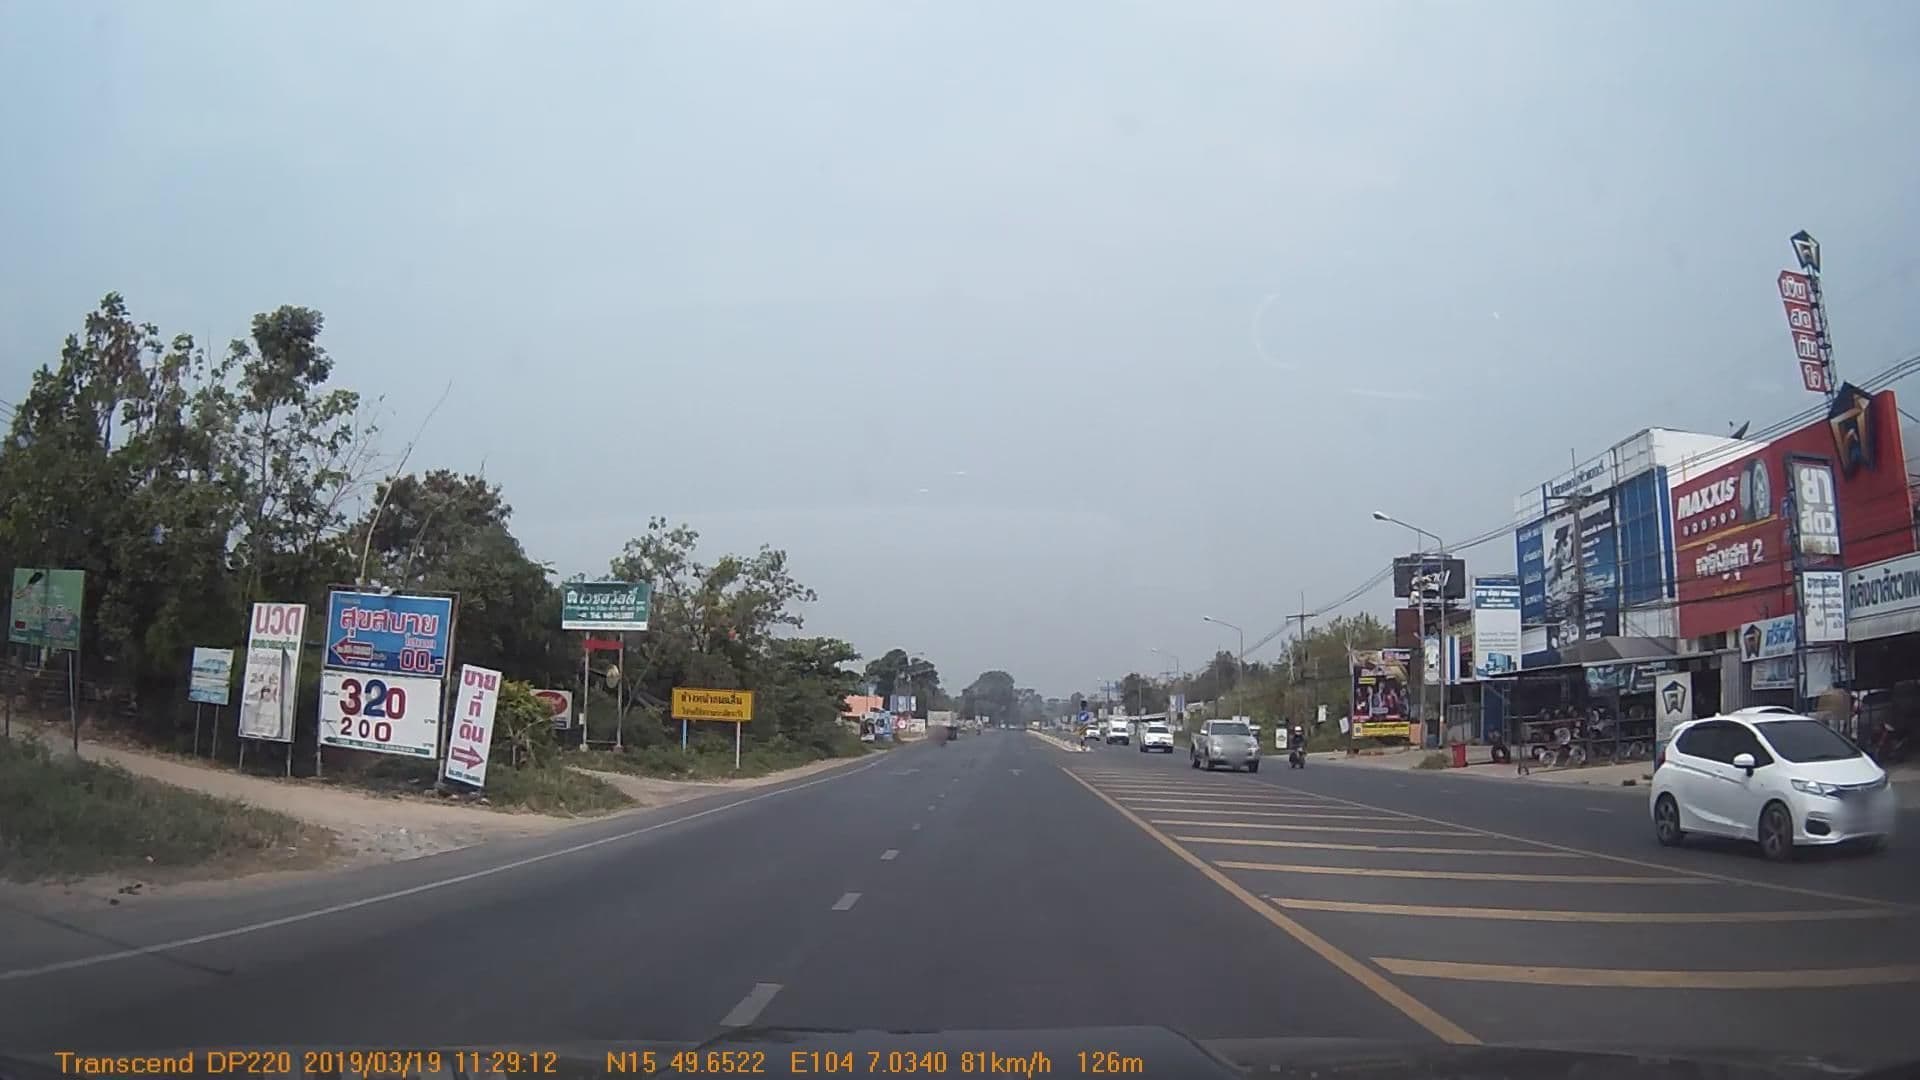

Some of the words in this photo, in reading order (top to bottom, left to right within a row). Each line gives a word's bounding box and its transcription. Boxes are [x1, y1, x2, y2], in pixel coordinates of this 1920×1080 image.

[1677, 477, 1739, 520] MAXXIS
[1800, 467, 1833, 503] ยา
[1752, 538, 1764, 564] 2
[255, 605, 301, 635] นวด
[341, 606, 440, 638] สุขสบาย
[340, 678, 406, 719] 320
